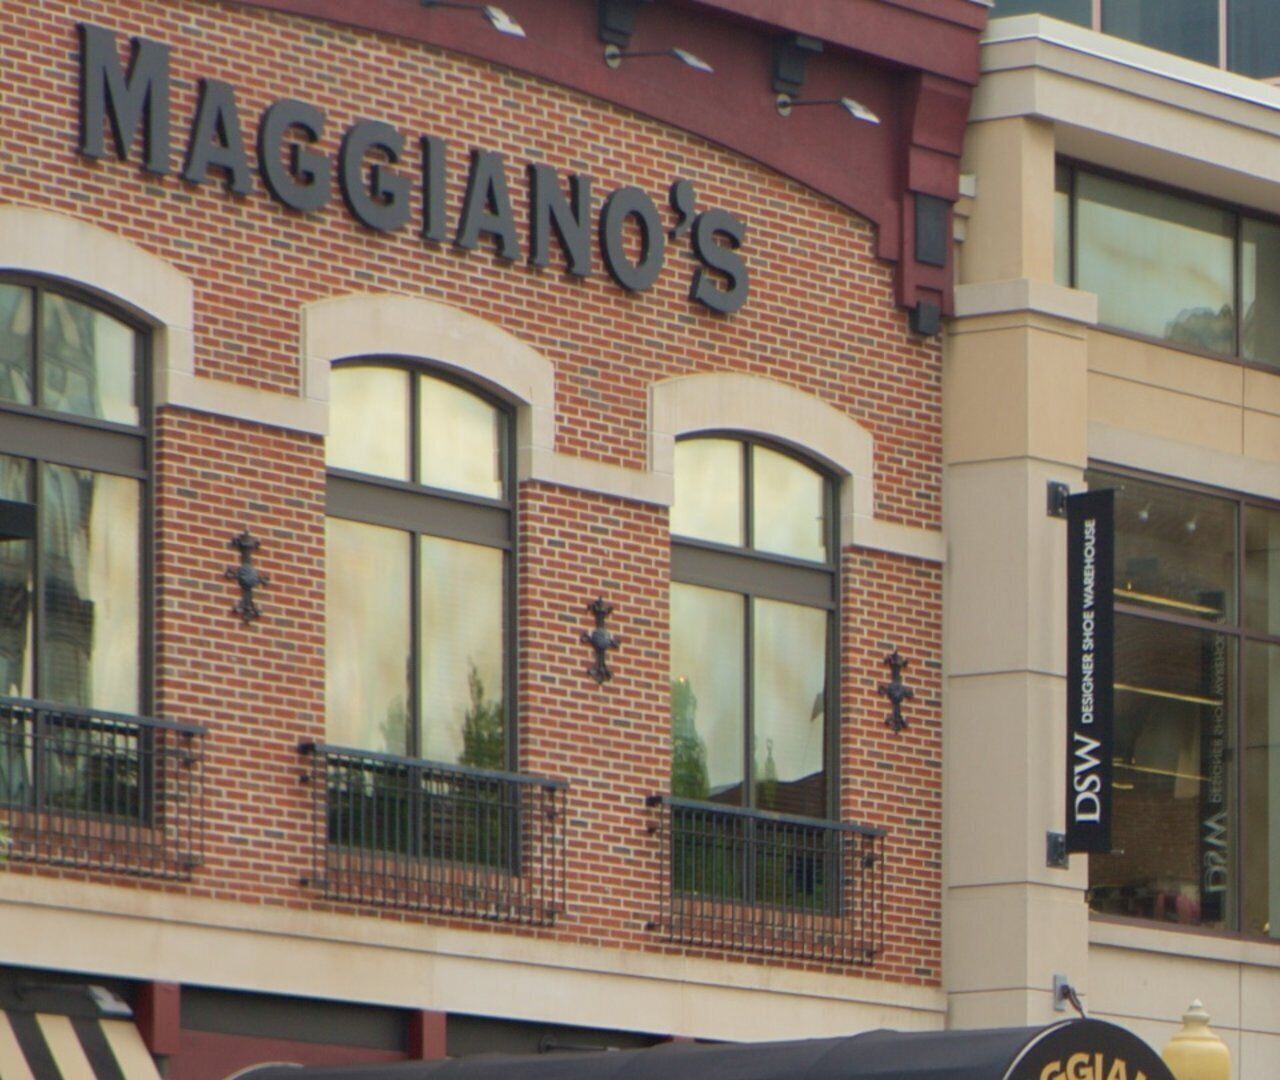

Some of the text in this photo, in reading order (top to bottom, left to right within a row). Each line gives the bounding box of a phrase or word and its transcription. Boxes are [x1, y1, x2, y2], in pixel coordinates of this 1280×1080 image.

[76, 22, 751, 315] MAGGIANO'S
[1073, 518, 1101, 825] DSW DESIGNER SHOE WAREHOUSE
